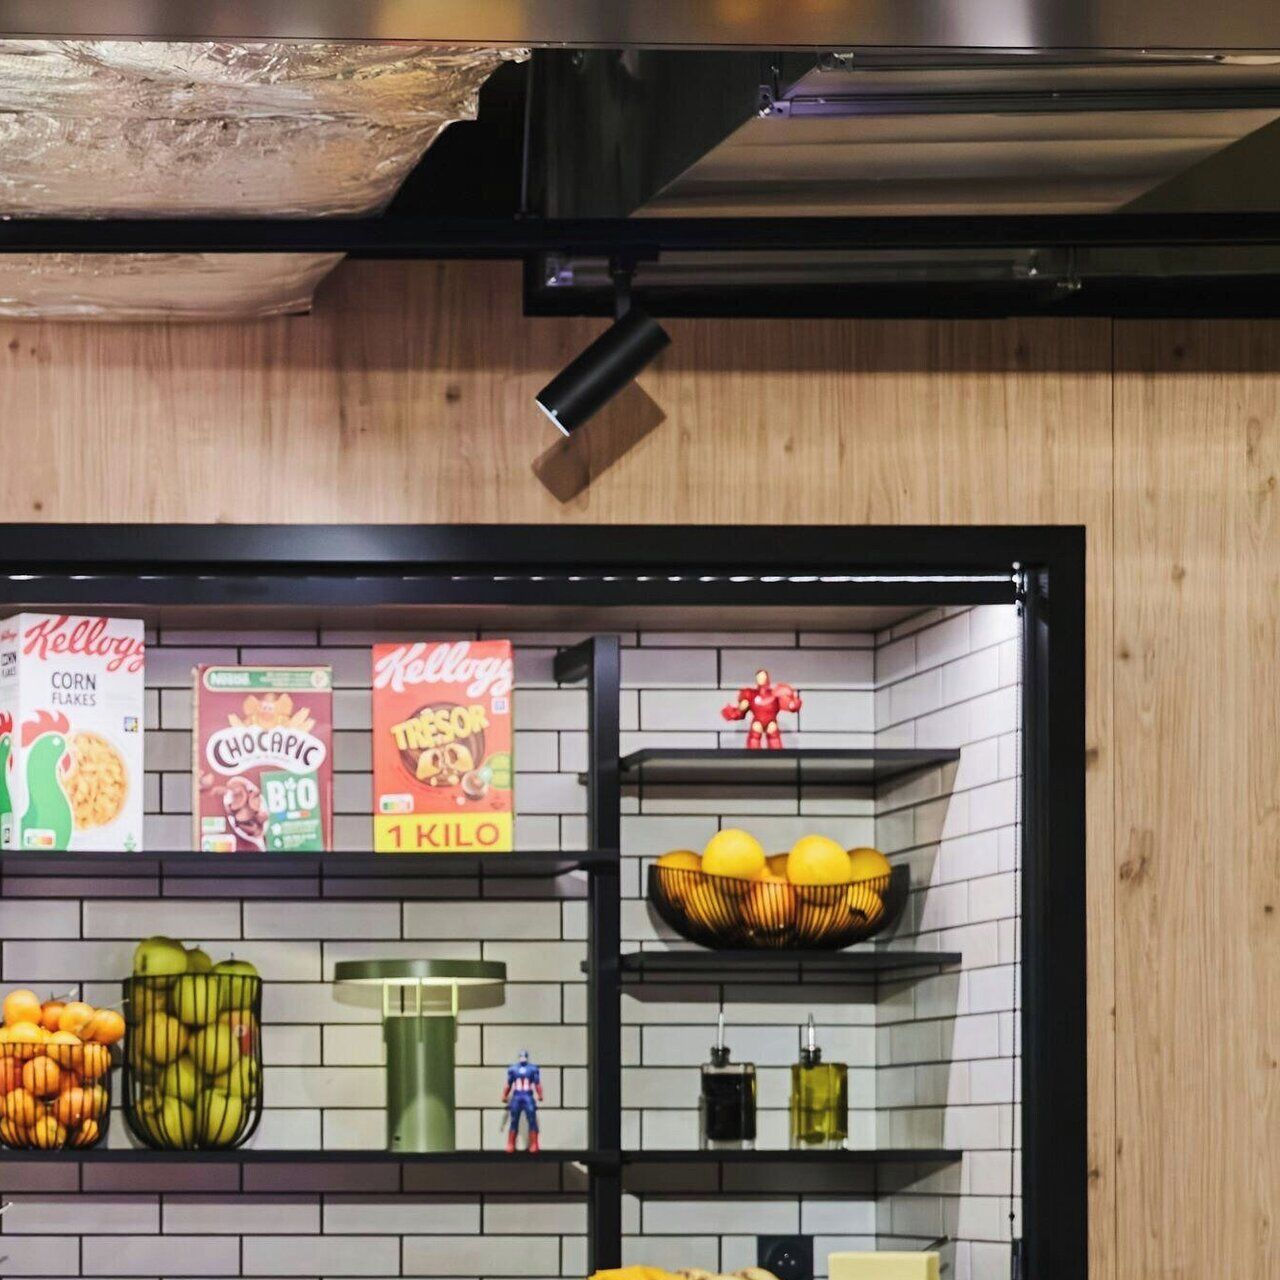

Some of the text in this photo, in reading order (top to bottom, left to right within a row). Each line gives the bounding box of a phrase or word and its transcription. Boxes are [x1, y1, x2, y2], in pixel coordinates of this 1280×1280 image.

[52, 671, 96, 690] CORN
[52, 691, 96, 706] FLAKES
[213, 731, 318, 768] CHOCAPIC
[388, 823, 500, 848] 1 KILO
